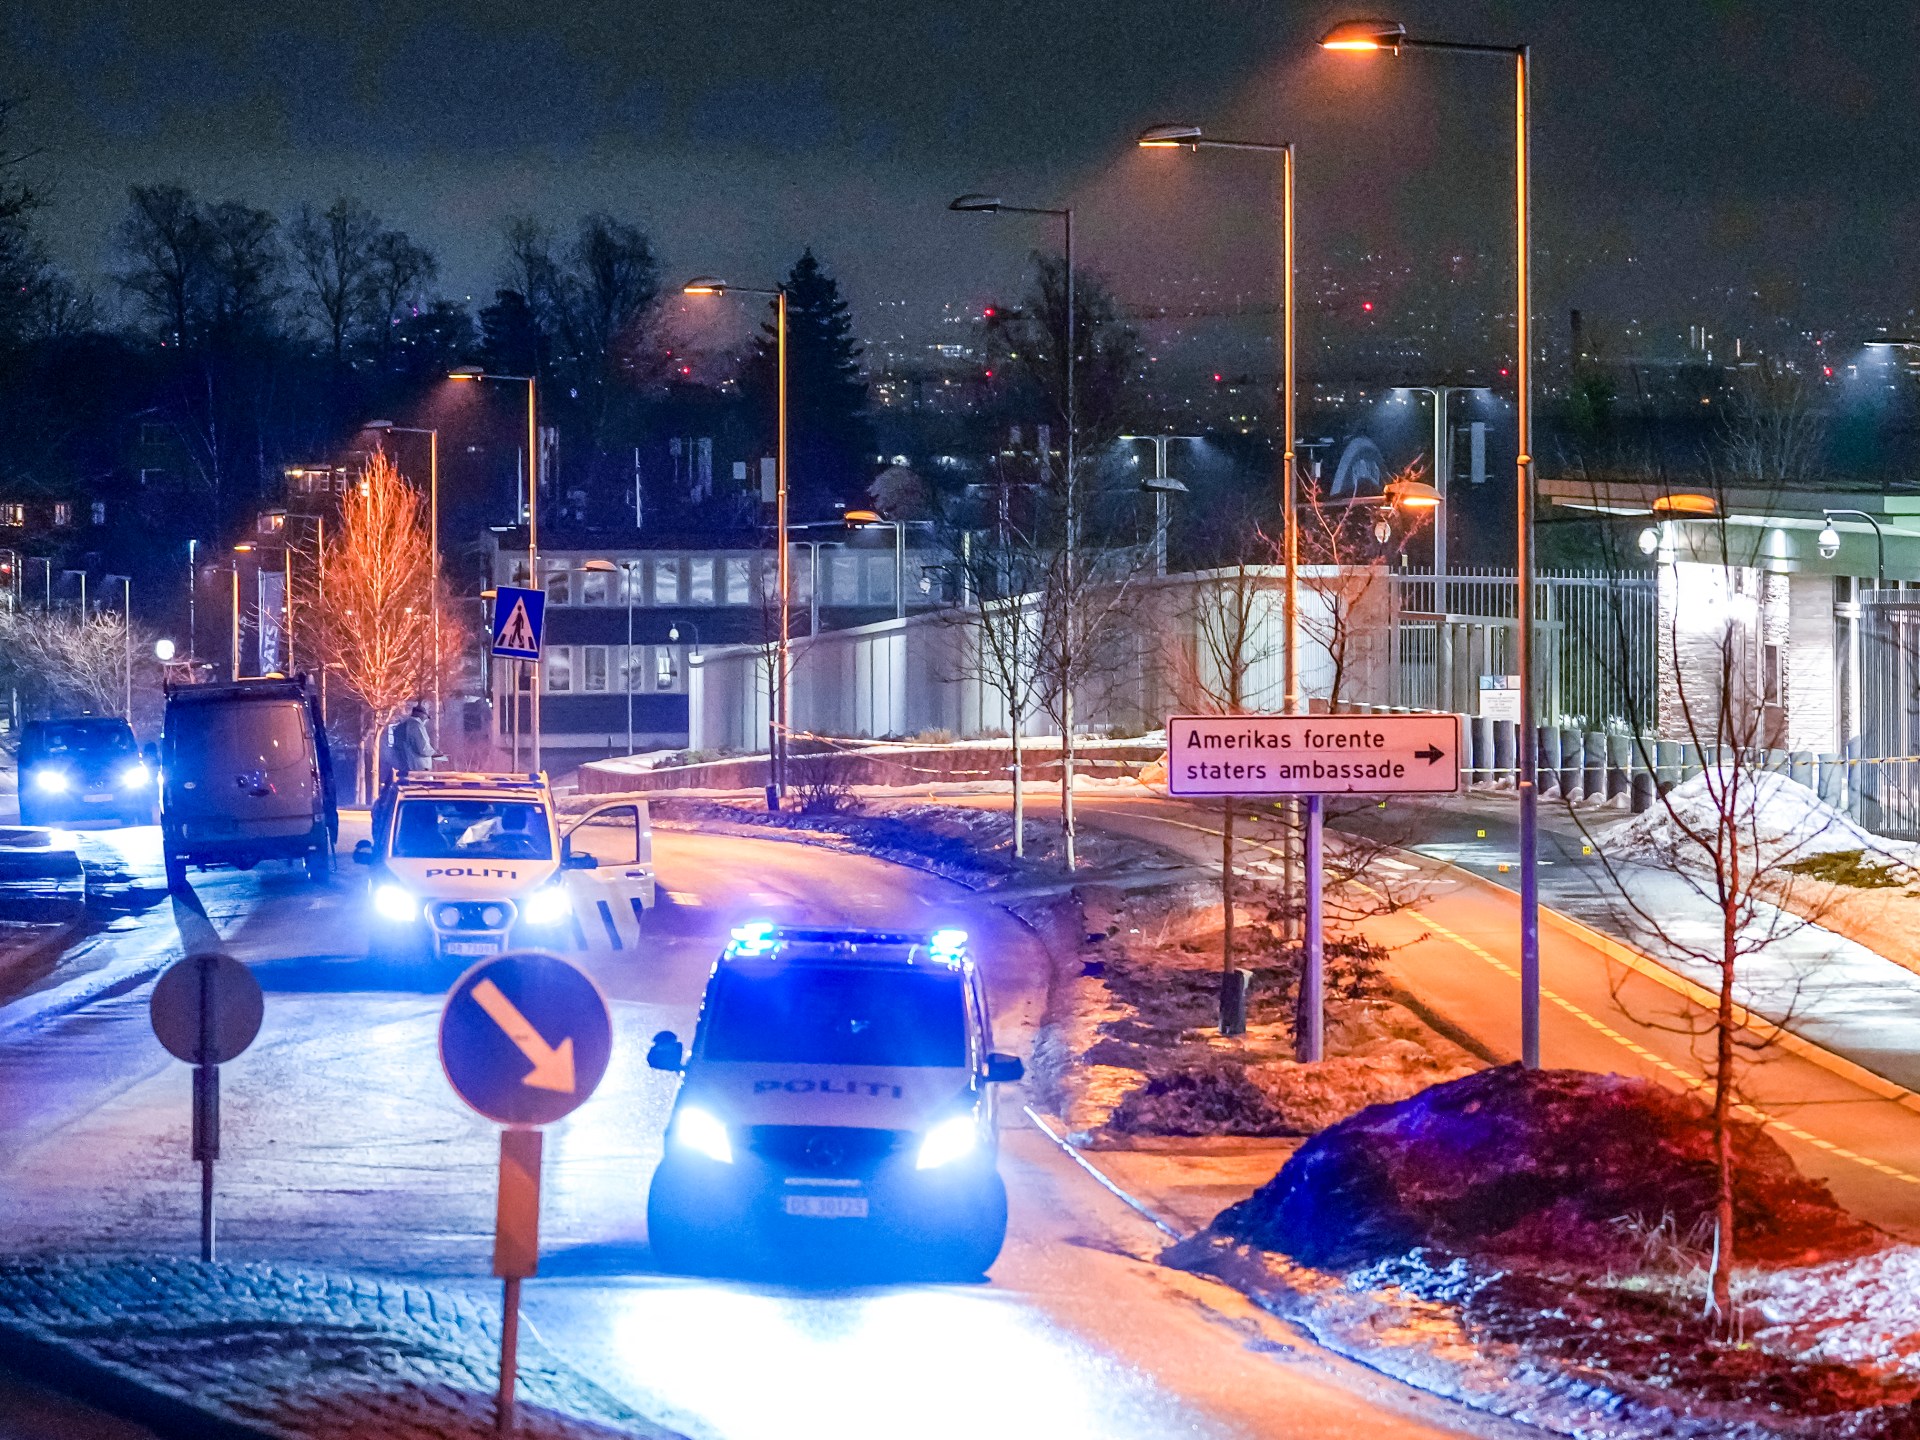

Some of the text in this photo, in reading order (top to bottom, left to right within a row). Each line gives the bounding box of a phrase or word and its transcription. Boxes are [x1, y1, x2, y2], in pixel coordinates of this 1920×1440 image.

[262, 624, 279, 673] SATS
[1187, 729, 1385, 749] Amerikas forente
[1187, 759, 1405, 779] staters ambassade
[426, 868, 517, 879] POLITI
[753, 1079, 903, 1100] POLITI
